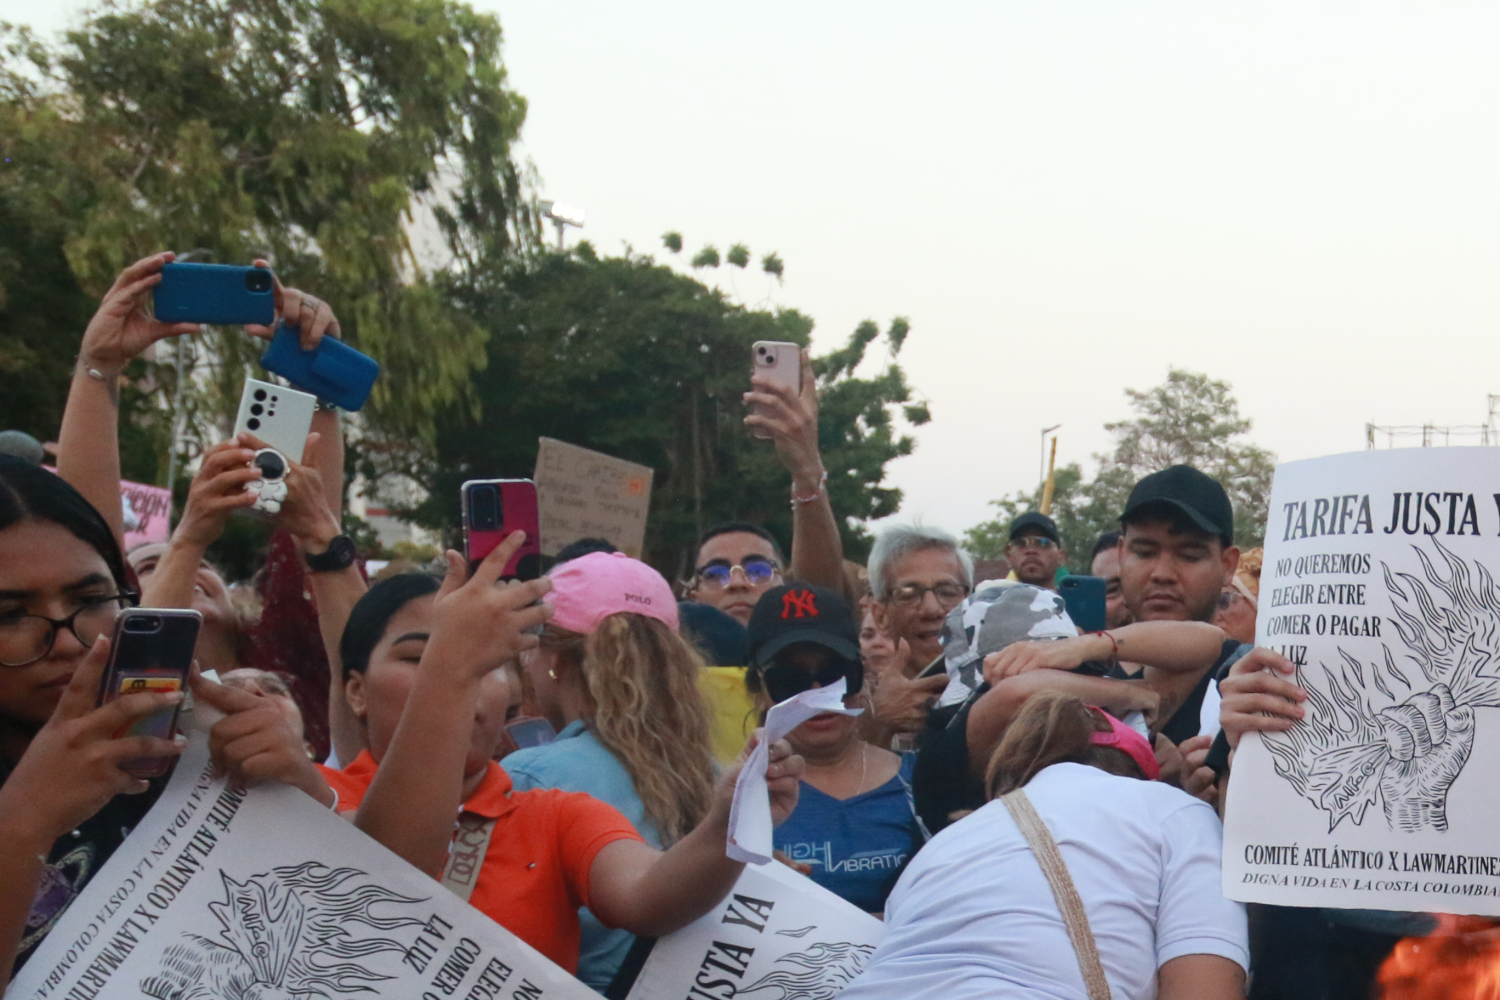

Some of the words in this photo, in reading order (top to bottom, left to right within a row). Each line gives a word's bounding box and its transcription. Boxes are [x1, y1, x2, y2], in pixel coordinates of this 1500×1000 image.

[1282, 494, 1373, 542] TARIFA
[1383, 492, 1481, 536] JUSTA
[1275, 557, 1292, 578] NO
[1294, 553, 1371, 578] QUEREMOS
[624, 593, 651, 606] POLO
[781, 589, 819, 620] NY
[1270, 584, 1314, 608] ELEGIR
[1317, 584, 1366, 605] ENTRE
[1267, 615, 1311, 637] COMER
[1316, 614, 1326, 636] O
[1330, 615, 1382, 638] PAGAR
[165, 801, 198, 834] VIDA
[206, 786, 248, 833] OMITÉ
[150, 839, 173, 861] EN
[1244, 842, 1299, 866] COMITÉ
[1303, 844, 1383, 870] ATLÁNTICO
[1388, 851, 1399, 872] X
[132, 860, 156, 880] LA
[147, 826, 218, 909] ATLÁNTICO
[1242, 872, 1288, 886] DIGNA
[1293, 876, 1326, 888] VIDA
[1330, 878, 1350, 889] EN
[1353, 879, 1372, 891] LA
[1375, 880, 1419, 892] COSTA
[96, 878, 137, 923] COSTA
[721, 893, 775, 934] YA
[134, 908, 159, 926] X
[422, 913, 454, 941] LA
[402, 936, 438, 975] LUZ
[431, 937, 482, 997] COMER
